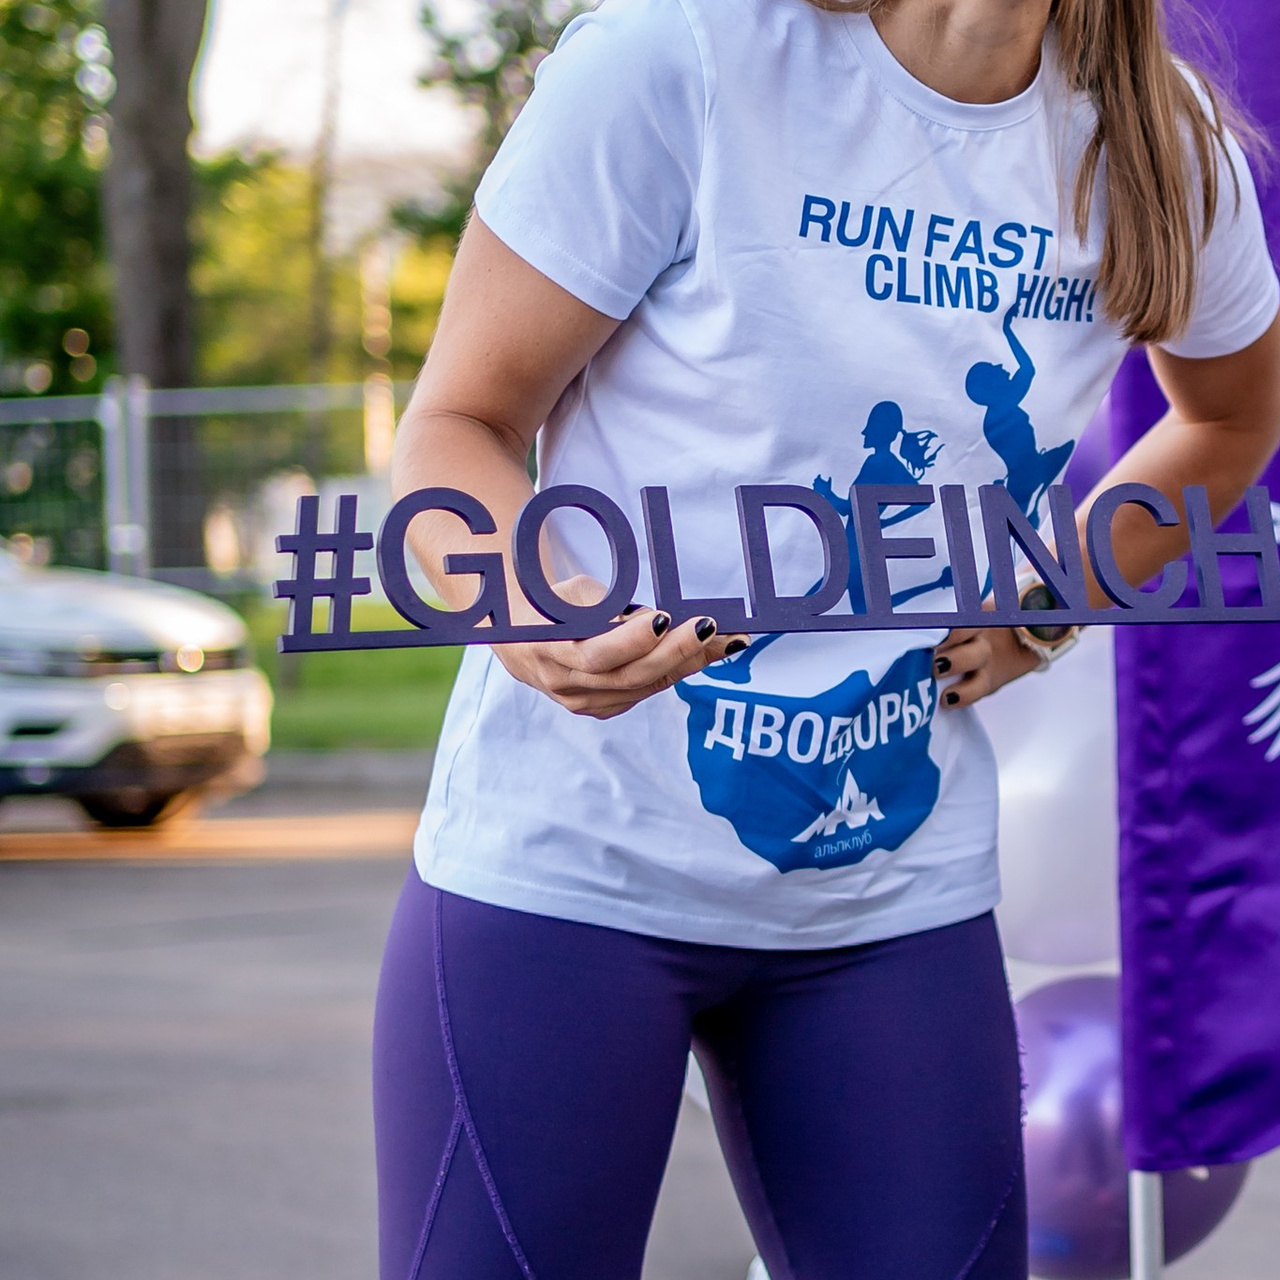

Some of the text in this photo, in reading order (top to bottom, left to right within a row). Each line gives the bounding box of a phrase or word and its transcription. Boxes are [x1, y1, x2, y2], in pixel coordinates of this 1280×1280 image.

[798, 194, 1054, 270] RUN FAST
[865, 254, 1098, 323] CLIMB HIGH!
[814, 828, 872, 858] альпклуб
